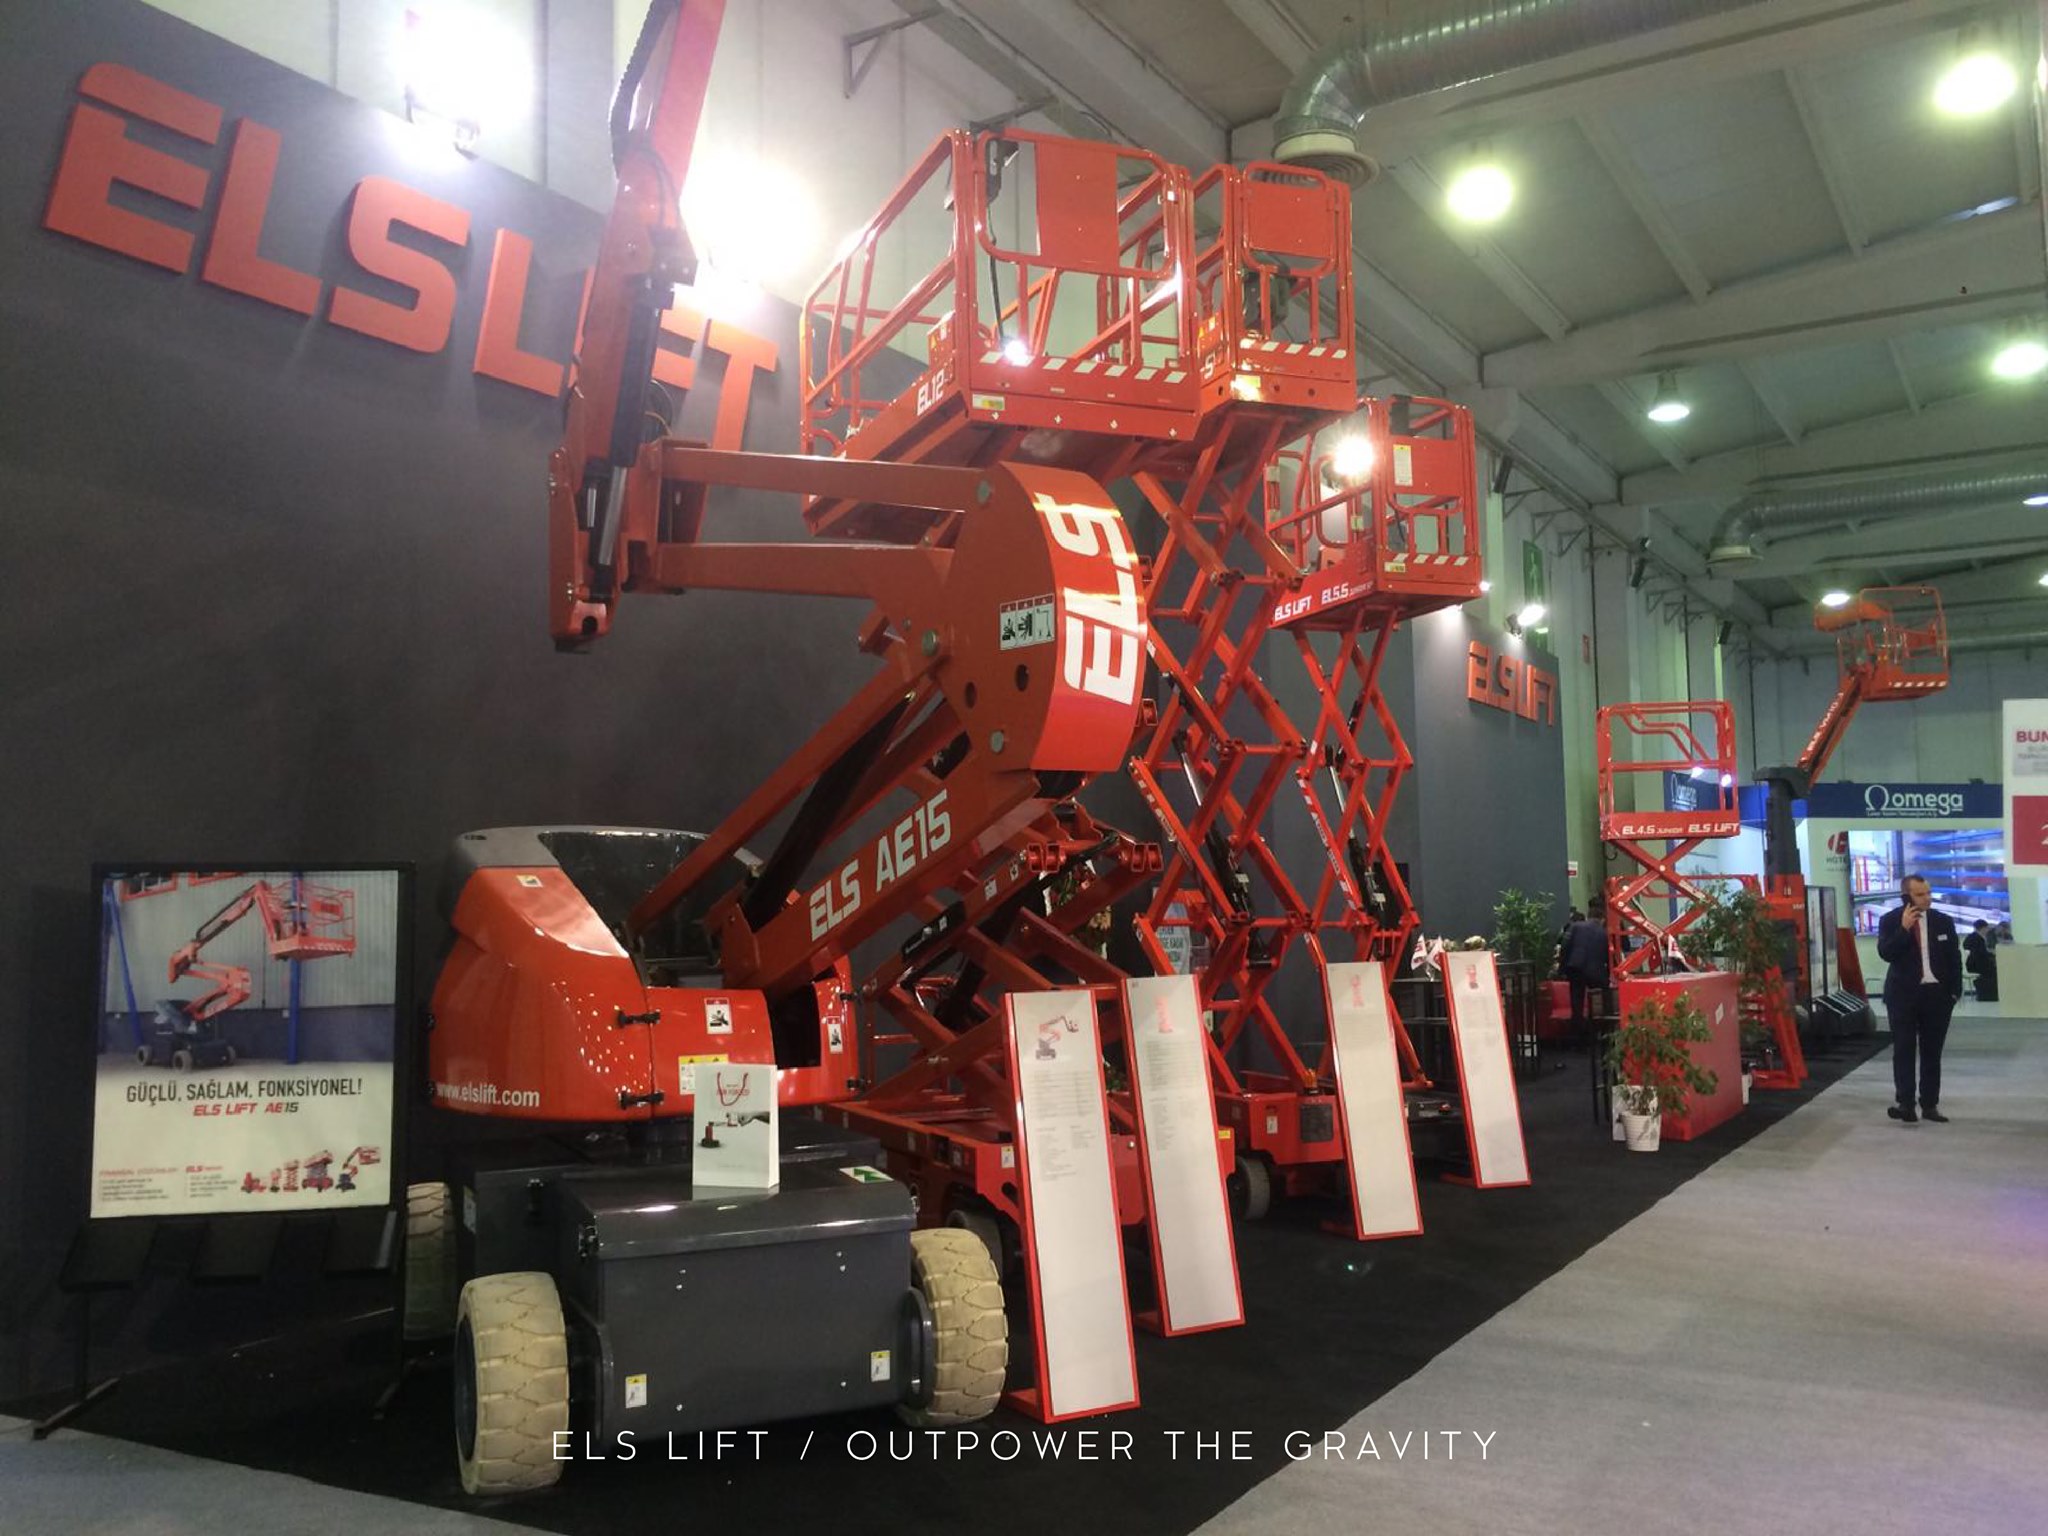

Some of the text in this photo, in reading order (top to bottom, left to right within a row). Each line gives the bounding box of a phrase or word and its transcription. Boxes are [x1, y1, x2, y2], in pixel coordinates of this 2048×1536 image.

[42, 61, 472, 355] ELS
[1292, 595, 1312, 616] LIFT
[1891, 792, 1964, 816] omega
[1688, 822, 1712, 834] ELS
[1713, 821, 1740, 834] LIFT
[809, 788, 952, 943] ELS AE15
[258, 1078, 363, 1097] FONKSİYONEL!
[436, 1082, 541, 1108] www.elslift.com
[193, 1101, 299, 1117] ELS LIFT AE15
